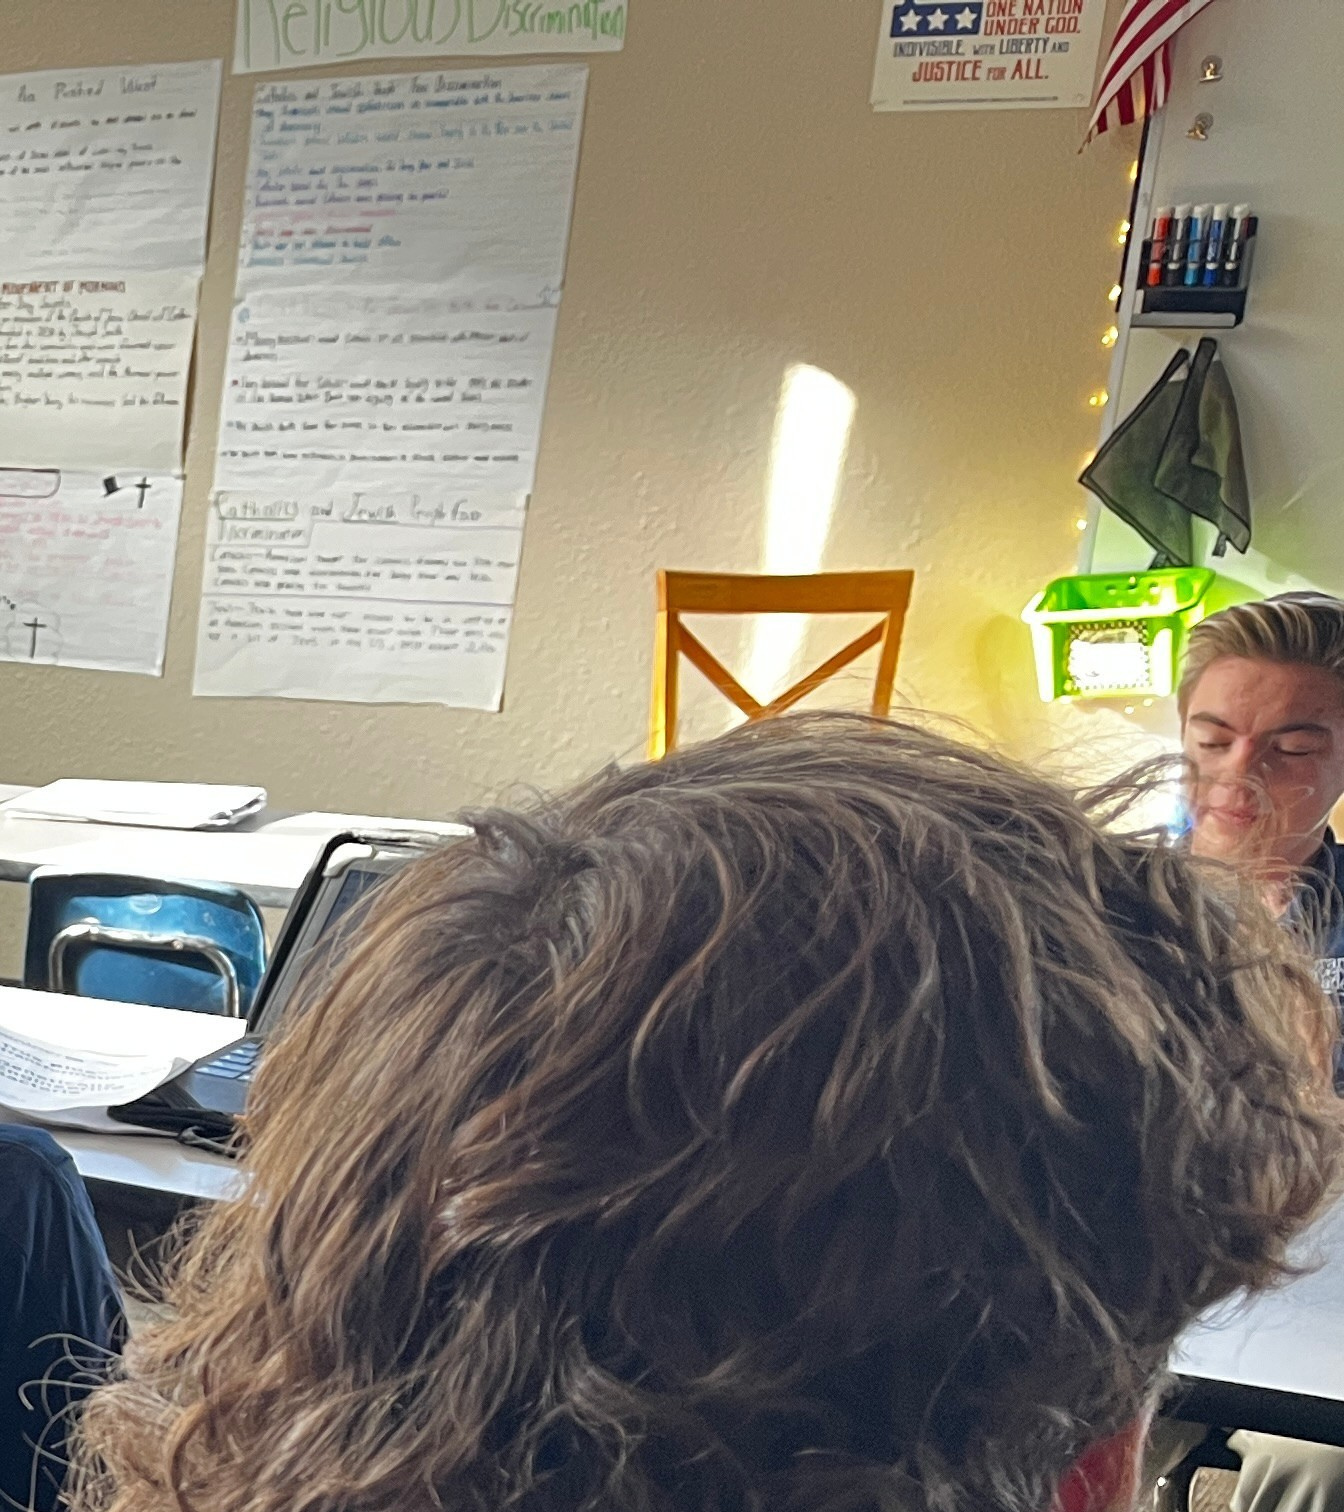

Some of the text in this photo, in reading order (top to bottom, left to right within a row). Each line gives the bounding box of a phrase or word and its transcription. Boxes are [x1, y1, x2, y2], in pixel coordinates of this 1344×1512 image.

[986, 0, 1082, 17] ONE NATION
[984, 16, 1081, 36] UNDER GOD.
[999, 37, 1050, 56] LIBERTY
[912, 58, 1049, 82] JUSTICE FOR ALL.
